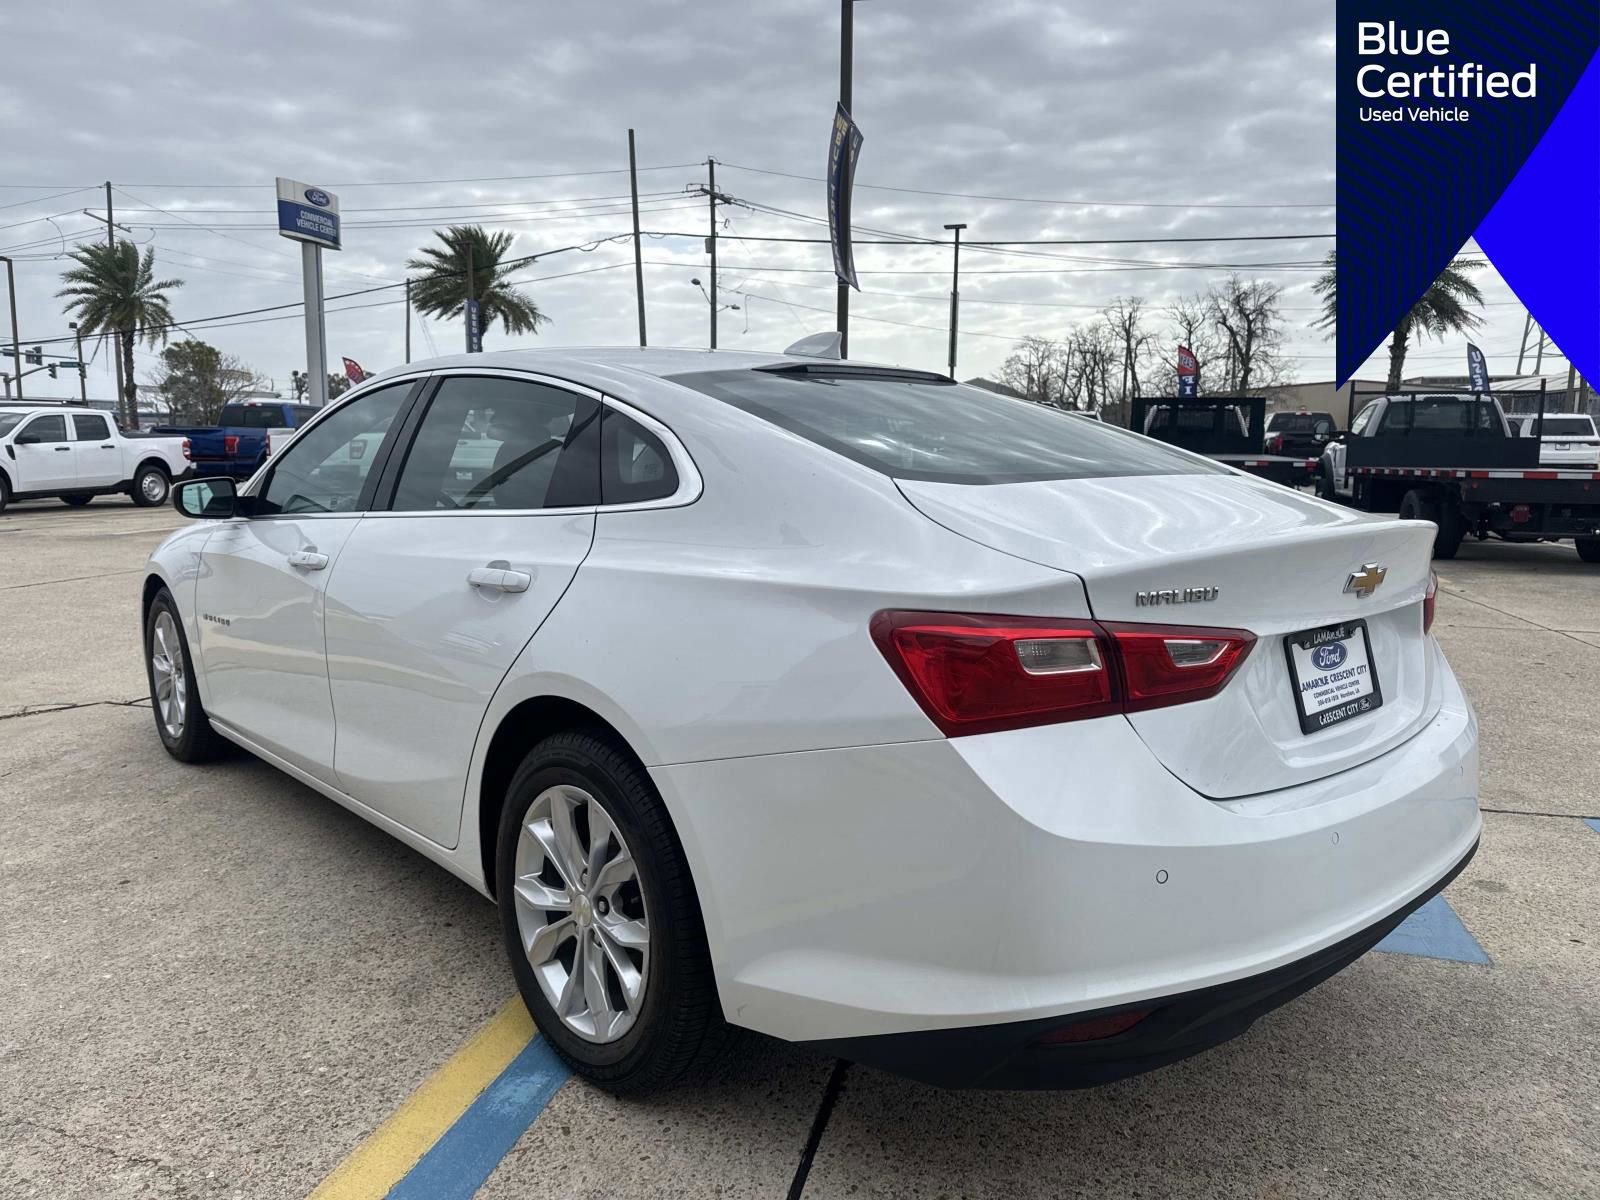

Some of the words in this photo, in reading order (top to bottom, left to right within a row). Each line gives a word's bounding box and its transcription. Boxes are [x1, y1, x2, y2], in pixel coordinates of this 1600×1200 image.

[296, 218, 319, 232] VEHICLE
[320, 224, 337, 237] CENTER
[300, 210, 333, 227] COMMERCIAL
[1135, 586, 1219, 607] MALIBU
[1320, 646, 1341, 667] Ford
[1329, 669, 1355, 684] CRESCENT
[1356, 664, 1367, 676] CITY
[1319, 708, 1346, 725] CRESCENT
[1347, 702, 1359, 715] CITY
